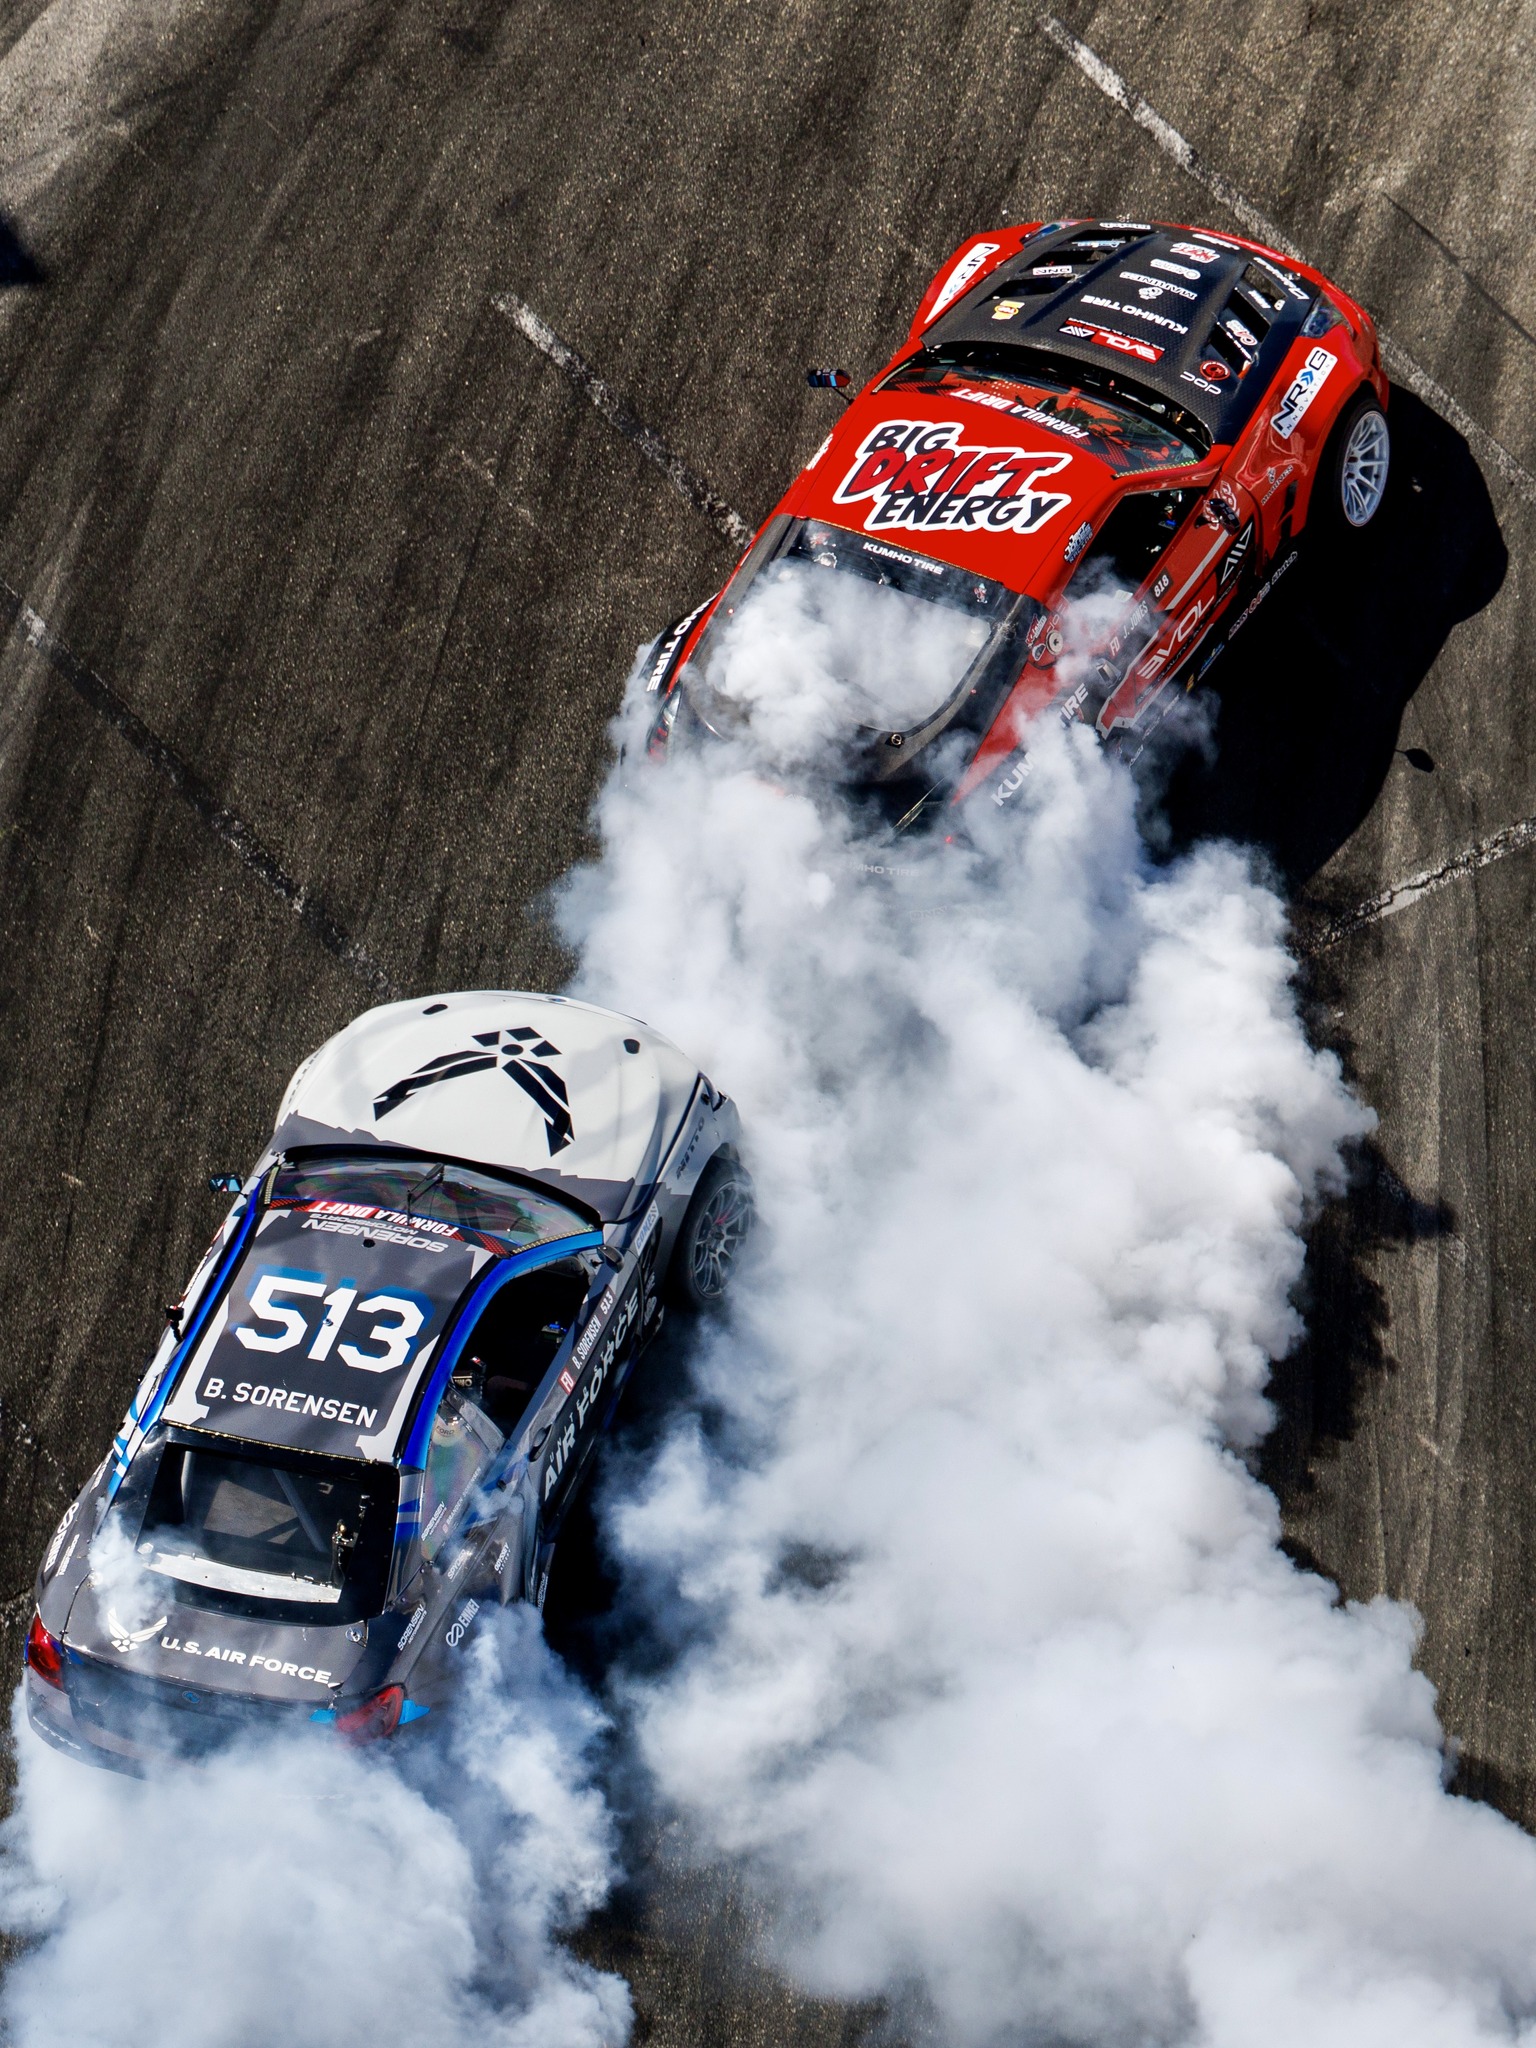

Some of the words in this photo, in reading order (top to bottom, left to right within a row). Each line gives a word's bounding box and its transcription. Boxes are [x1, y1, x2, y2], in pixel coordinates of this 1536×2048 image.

[1081, 294, 1122, 312] TIRE
[1121, 304, 1188, 335] KUMHO
[950, 389, 1017, 412] DRIFT
[1010, 404, 1090, 439] FORMULA
[863, 424, 957, 455] BIG
[841, 447, 1065, 498] DRIFT
[871, 494, 1065, 529] ENERGY
[863, 542, 912, 565] KUMHO
[911, 556, 944, 575] TIRE
[1109, 636, 1120, 657] FD
[1130, 600, 1149, 631] JONES
[1153, 574, 1169, 598] 818
[646, 636, 682, 692] TIRE
[991, 751, 1035, 807] KUM
[676, 1116, 705, 1180] NITTO
[308, 1201, 377, 1219] DRIFT
[309, 1213, 419, 1236] MOTORSPORTS
[373, 1208, 459, 1237] FORMULA
[301, 1219, 449, 1253] SORENSEN
[600, 1290, 614, 1315] 513
[234, 1274, 426, 1374] 513
[576, 1314, 602, 1360] SORENSEN
[571, 1355, 583, 1370] B.
[544, 1420, 577, 1502] AIR
[577, 1287, 639, 1430] FORCE
[560, 1370, 574, 1392] FD
[203, 1377, 227, 1400] B.
[232, 1382, 378, 1429] SORENSEN
[421, 1501, 445, 1541] SORENSEN
[446, 1498, 463, 1525] BRANDEN
[397, 1604, 424, 1651] SORENSEN
[408, 1610, 428, 1645] MOTORSPORTS
[458, 1598, 480, 1628] ENKEI
[160, 1636, 202, 1655] U.S.
[204, 1647, 247, 1665] AIR
[249, 1655, 332, 1685] FORCE
